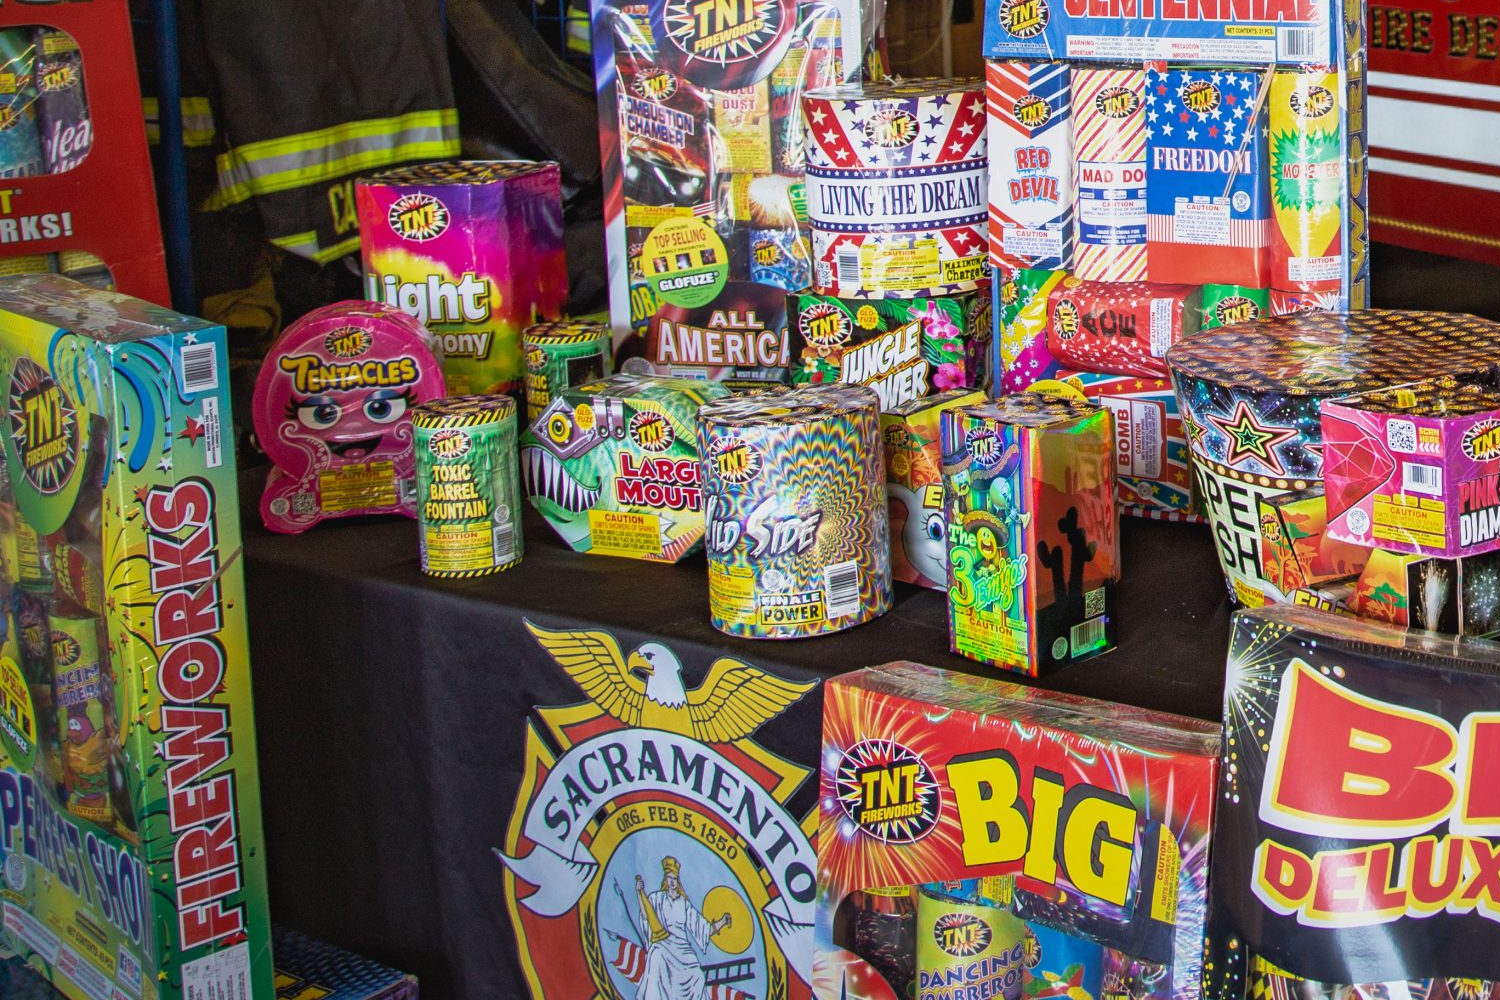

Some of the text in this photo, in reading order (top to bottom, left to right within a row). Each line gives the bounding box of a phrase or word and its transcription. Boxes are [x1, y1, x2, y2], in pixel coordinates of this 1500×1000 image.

[1010, 0, 1039, 26] TNT
[693, 18, 765, 55] FIREWORKS
[1371, 8, 1435, 54] IRE
[642, 72, 668, 95] TNT
[722, 99, 756, 110] DUST
[1103, 93, 1130, 112] TNT
[1189, 89, 1214, 107] TNT
[1020, 103, 1045, 120] TNT
[626, 112, 686, 150] CHAMBER
[880, 115, 911, 140] TNT
[1015, 146, 1052, 172] RED
[1152, 146, 1252, 175] FREEDOM
[1083, 168, 1147, 183] MAD DO
[819, 182, 874, 217] LIVING
[876, 184, 918, 216] THE
[919, 175, 981, 213] DREAM
[1009, 174, 1061, 203] DEVIL
[400, 205, 436, 236] TNT
[643, 206, 677, 214] CAUTION
[653, 228, 707, 250] TOP SELLING
[1015, 230, 1049, 238] CAUTION
[756, 246, 776, 260] TNT
[882, 249, 917, 257] CAUTION
[944, 257, 981, 270] MAXIMUM
[946, 267, 980, 282] Charge
[368, 270, 490, 327] Light
[708, 310, 765, 330] ALL
[1057, 308, 1072, 334] TNT
[1223, 303, 1249, 319] TNT
[809, 314, 838, 340] TNT
[333, 333, 363, 352] TNT
[840, 319, 922, 384] JUNGLE
[279, 354, 421, 394] TENTACLES
[1035, 387, 1062, 395] CONTAINS
[24, 387, 64, 449] TNT
[637, 421, 665, 445] TNT
[889, 431, 904, 443] TNT
[1118, 407, 1131, 467] BOMB
[1418, 426, 1440, 437] SCAN
[1418, 435, 1440, 445] HERE
[26, 435, 67, 468] FIREWORKS
[435, 434, 464, 455] TNT
[973, 439, 996, 455] TNT
[432, 463, 472, 482] TOXIC
[717, 451, 748, 475] TNT
[429, 482, 480, 501] BARREL
[615, 478, 703, 512] MOUT
[425, 500, 488, 520] FOUNTAIN
[604, 513, 644, 525] CAUTION
[1390, 506, 1428, 520] CAUTION
[435, 531, 478, 539] CAUTION
[745, 492, 823, 559] SIDE
[948, 523, 977, 547] The
[1264, 523, 1277, 535] TNT
[950, 546, 976, 607] 3
[760, 591, 821, 606] FINALE
[1235, 581, 1264, 599] CAUTION
[762, 603, 821, 621] POWER
[969, 617, 1014, 637] CAUTION
[146, 476, 243, 952] FIREWORKS
[861, 763, 921, 806] TNT
[543, 739, 818, 904] SACRAMENTO
[860, 801, 924, 825] FIREWORKS
[0, 769, 94, 907] PERFECT
[616, 805, 739, 861] ORG. FEB 5, 1850
[945, 748, 1138, 907] BIG
[1156, 839, 1167, 881] CAUTION
[943, 925, 979, 946] TNT
[919, 942, 1025, 989] DANCING
